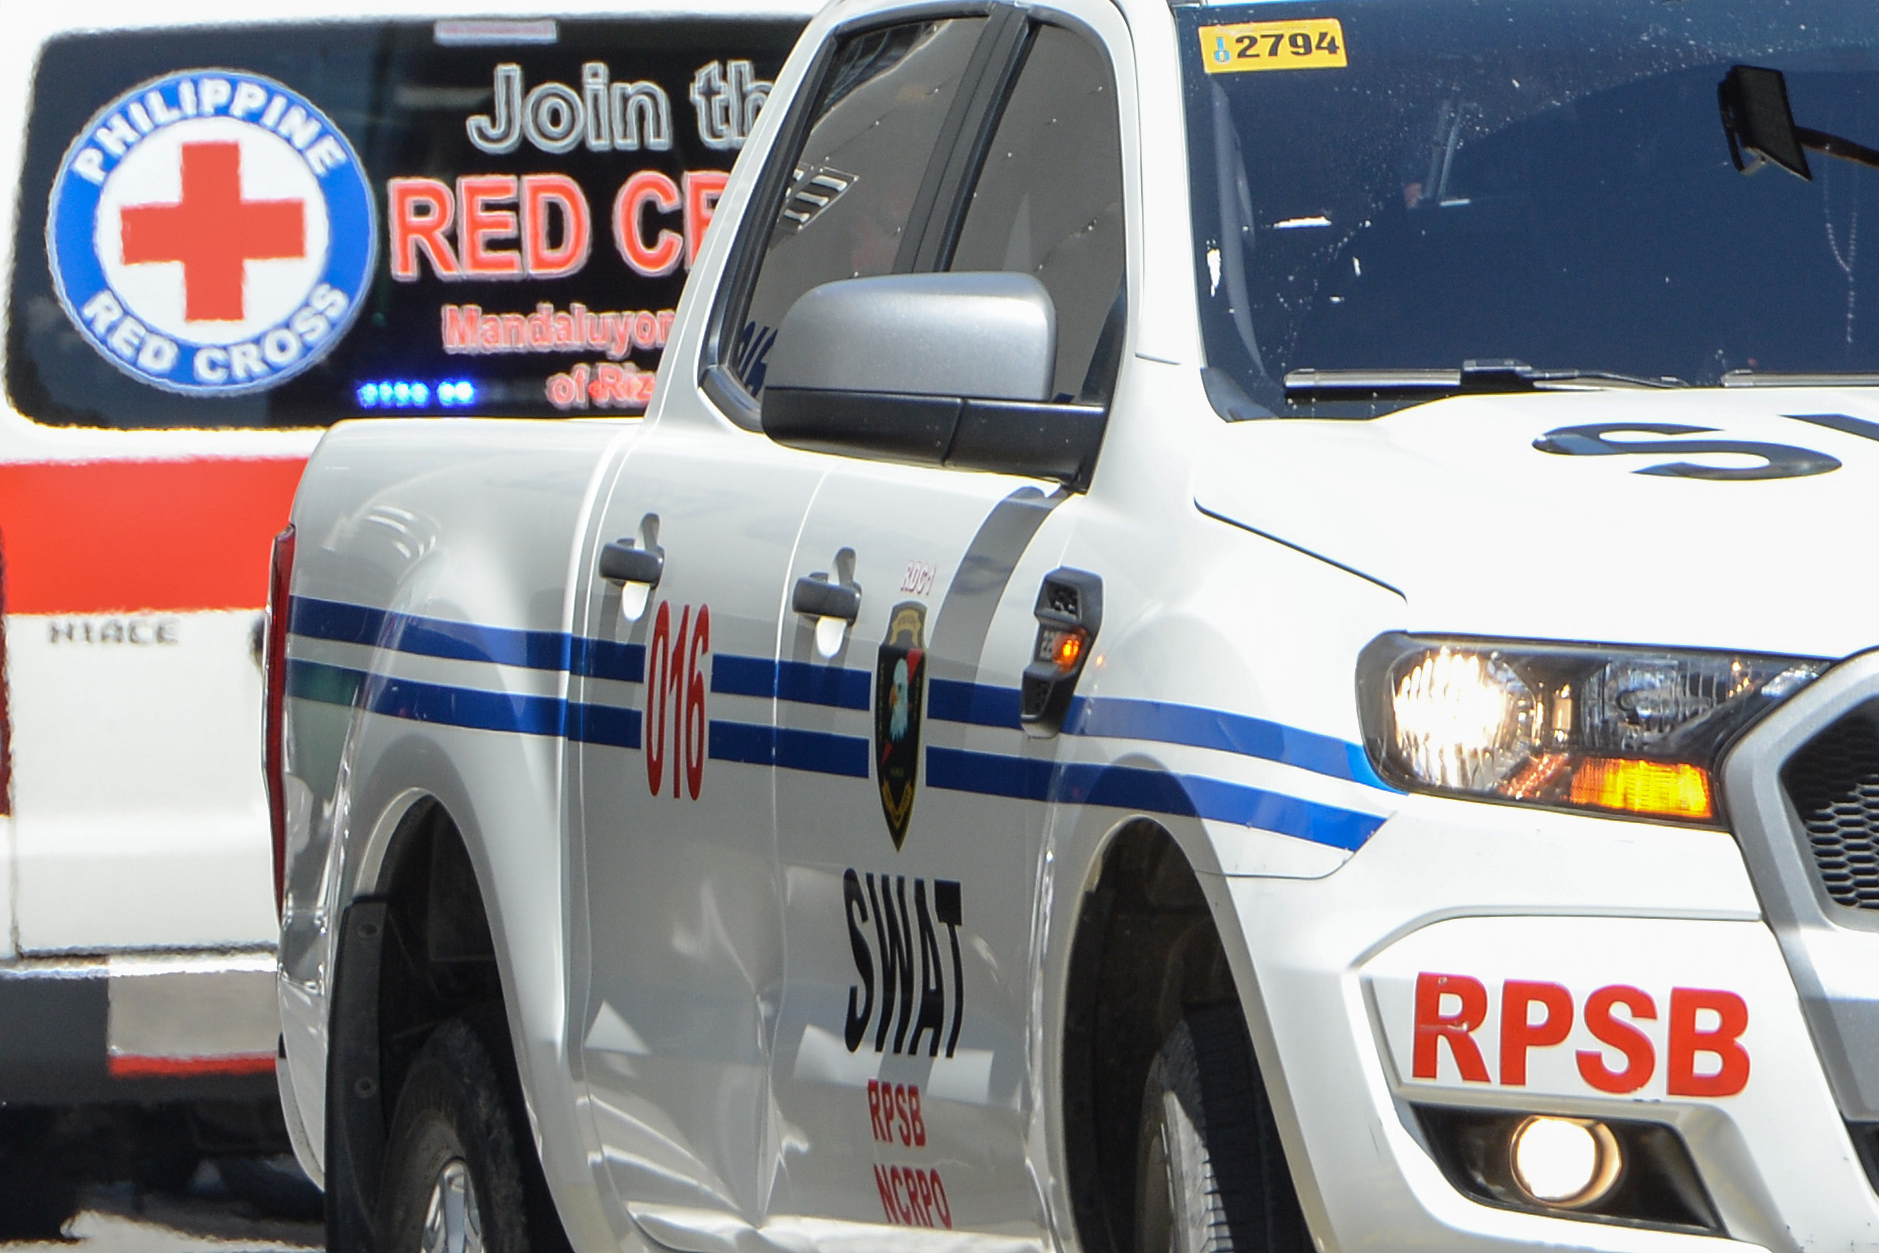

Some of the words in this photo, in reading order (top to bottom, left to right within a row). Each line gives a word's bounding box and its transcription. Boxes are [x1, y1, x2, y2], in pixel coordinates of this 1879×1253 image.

[1235, 32, 1339, 58] 2794
[71, 76, 348, 186] PHILIPPINE
[465, 62, 672, 155] Join
[690, 60, 776, 151] th
[388, 171, 592, 281] RED
[80, 289, 175, 375] RED
[192, 283, 351, 386] CROSS
[442, 302, 677, 360] Mandaluyon
[546, 363, 590, 409] of
[592, 362, 657, 407] Riz
[49, 618, 180, 644] HIACE
[645, 599, 711, 802] 016
[843, 867, 965, 1059] SWAT
[1412, 971, 1751, 1098] RPSB
[868, 1078, 926, 1148] RPSB
[873, 1164, 952, 1231] NCRPO
